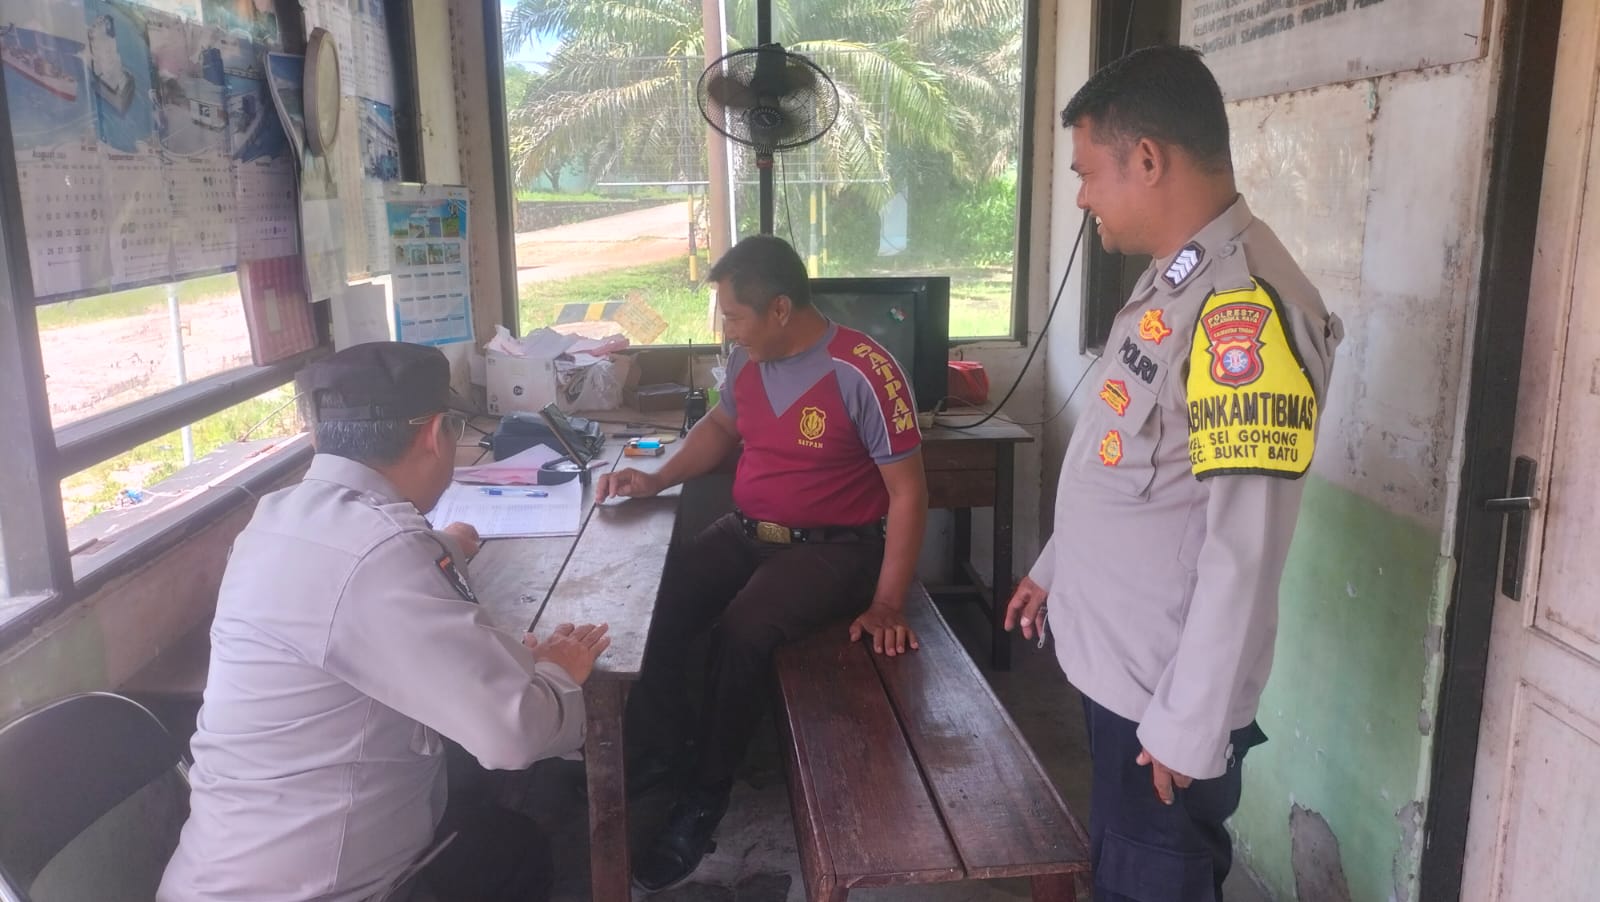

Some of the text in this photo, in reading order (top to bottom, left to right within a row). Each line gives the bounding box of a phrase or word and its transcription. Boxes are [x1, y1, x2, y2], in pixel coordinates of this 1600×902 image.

[1207, 309, 1260, 325] POLRESTA
[1119, 336, 1158, 384] POLRI
[852, 343, 914, 434] SATPAM
[1209, 430, 1229, 446] SEI
[1238, 429, 1298, 446] GOHONG
[1215, 445, 1258, 459] BUKIT
[1268, 446, 1298, 462] BATU
